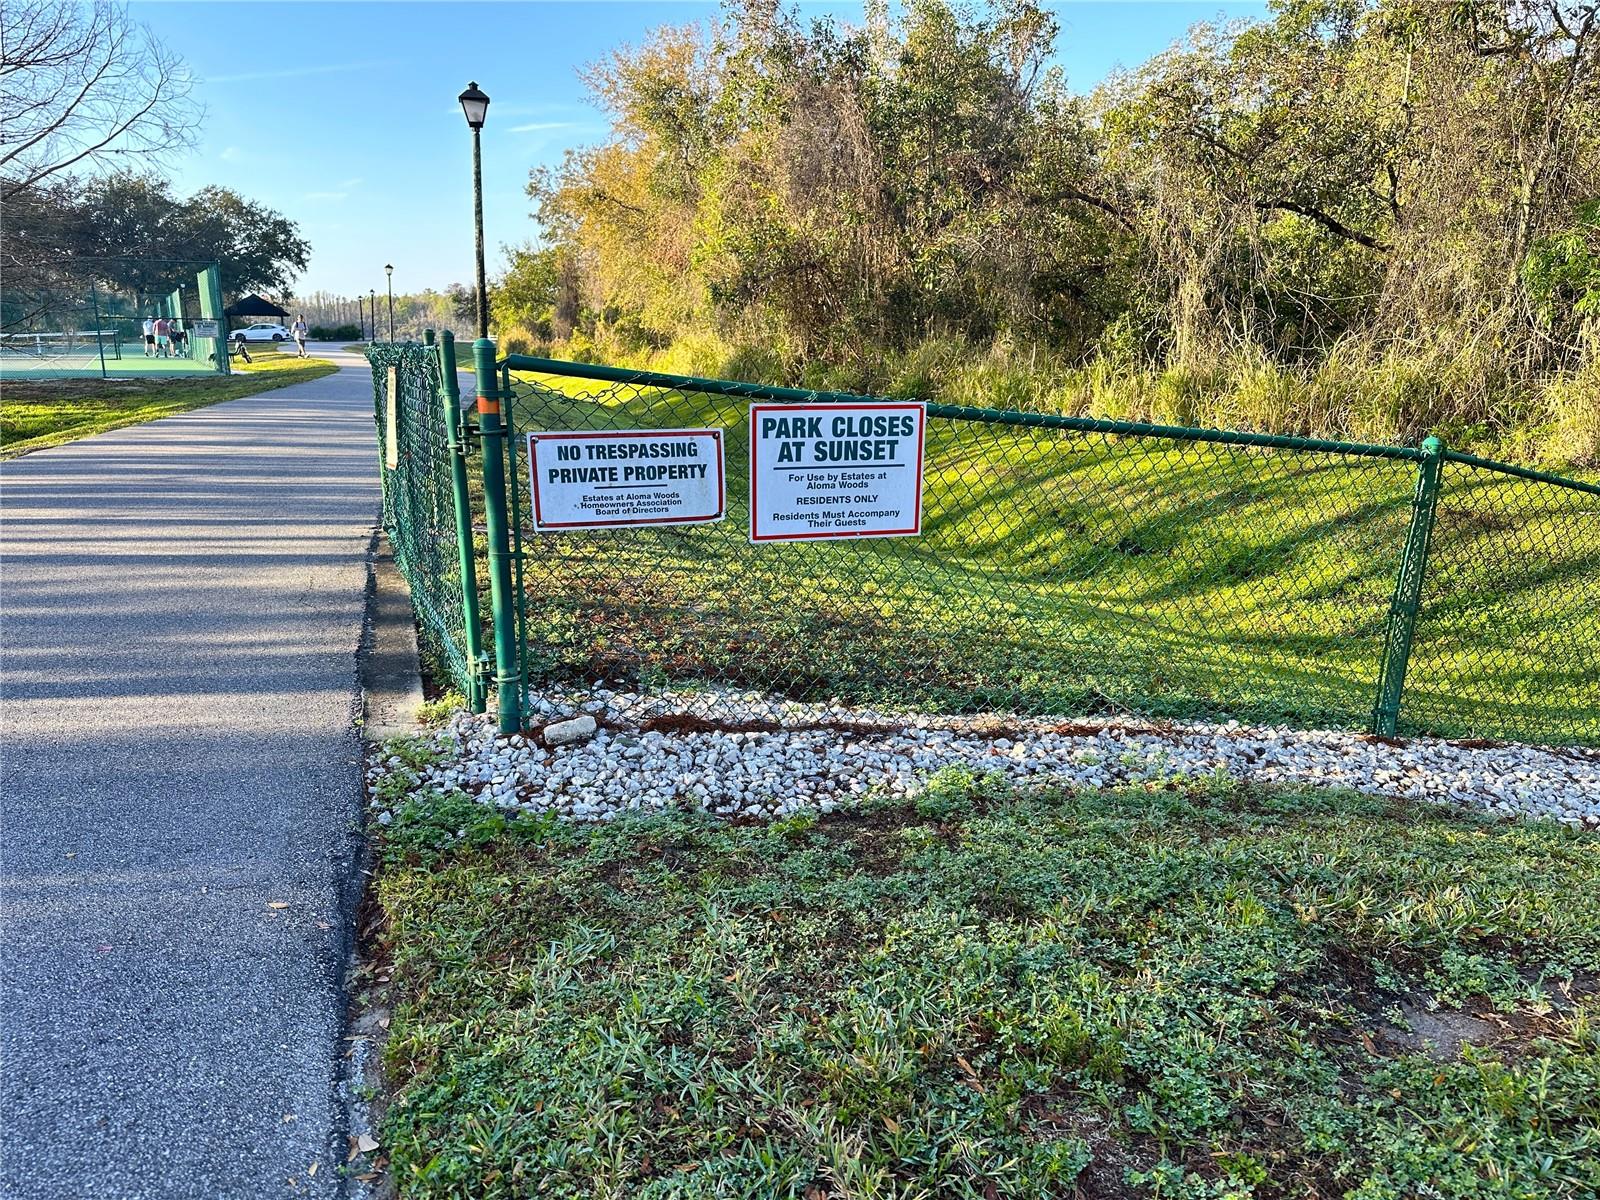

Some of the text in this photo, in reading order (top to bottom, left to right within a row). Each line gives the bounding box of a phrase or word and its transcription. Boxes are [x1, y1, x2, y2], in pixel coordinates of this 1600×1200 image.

[762, 415, 914, 439] PARK CLOSES
[557, 442, 698, 461] NO TRESPASSING
[777, 440, 899, 462] AT SUNSET
[548, 464, 708, 483] PRIVATE PROPERTY
[788, 474, 804, 482] For
[807, 473, 825, 481] Use
[827, 473, 838, 482] by
[841, 472, 875, 480] Estates
[806, 482, 836, 490] Aloma
[636, 499, 682, 507] Association
[796, 495, 878, 505] RESIDENTS ONLY
[632, 506, 669, 514] Directors
[773, 510, 900, 521] Residents Must Accompany
[808, 519, 866, 527] Their Guests
